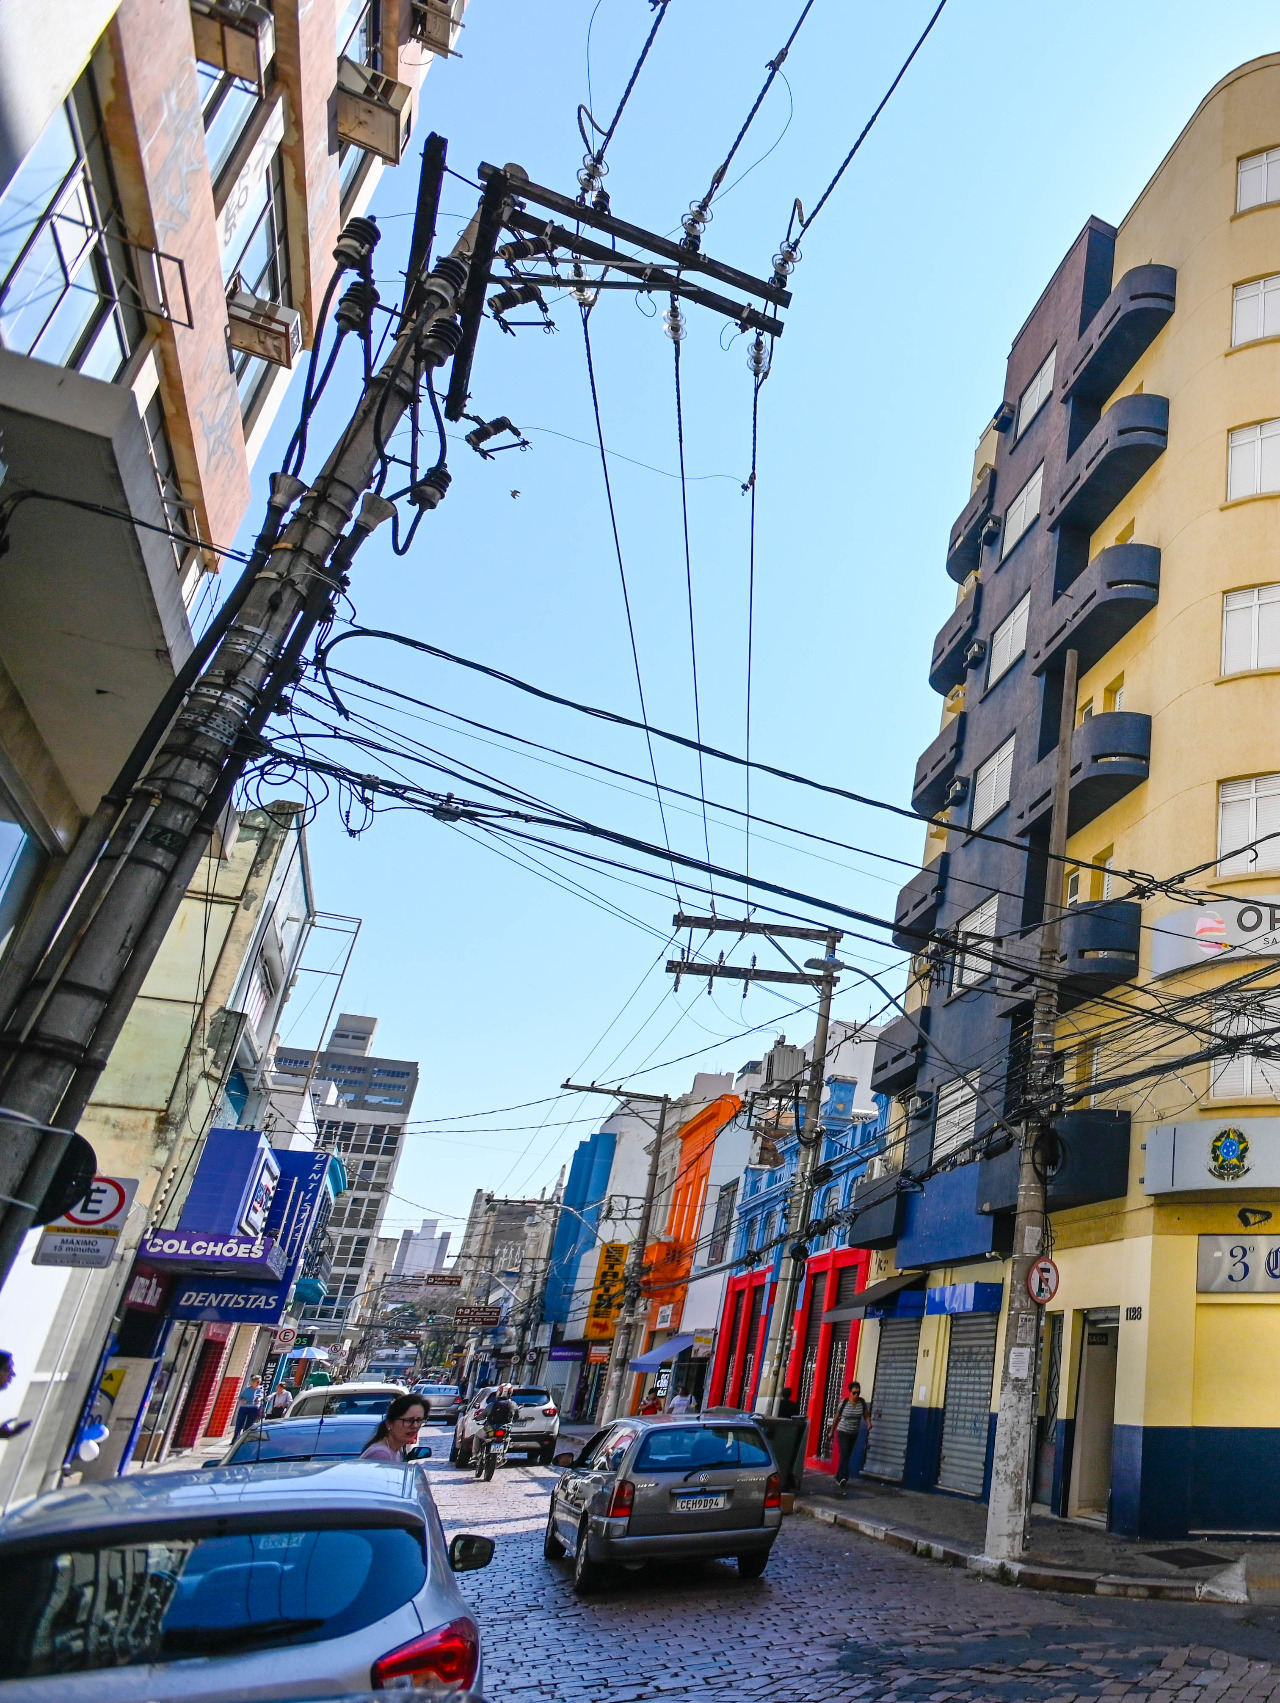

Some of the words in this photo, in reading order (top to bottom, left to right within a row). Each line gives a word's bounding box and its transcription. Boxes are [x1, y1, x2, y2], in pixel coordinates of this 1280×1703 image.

[291, 1153, 327, 1240] DENTISTAS
[60, 1237, 98, 1247] MÁXIMO
[146, 1238, 265, 1259] COLCHÕES
[53, 1245, 63, 1253] 15
[65, 1246, 100, 1254] minutos
[179, 1291, 279, 1309] DENTISTAS
[1125, 1306, 1142, 1321] 1128
[283, 1331, 291, 1340] E
[680, 1498, 720, 1511] CEH9D94
